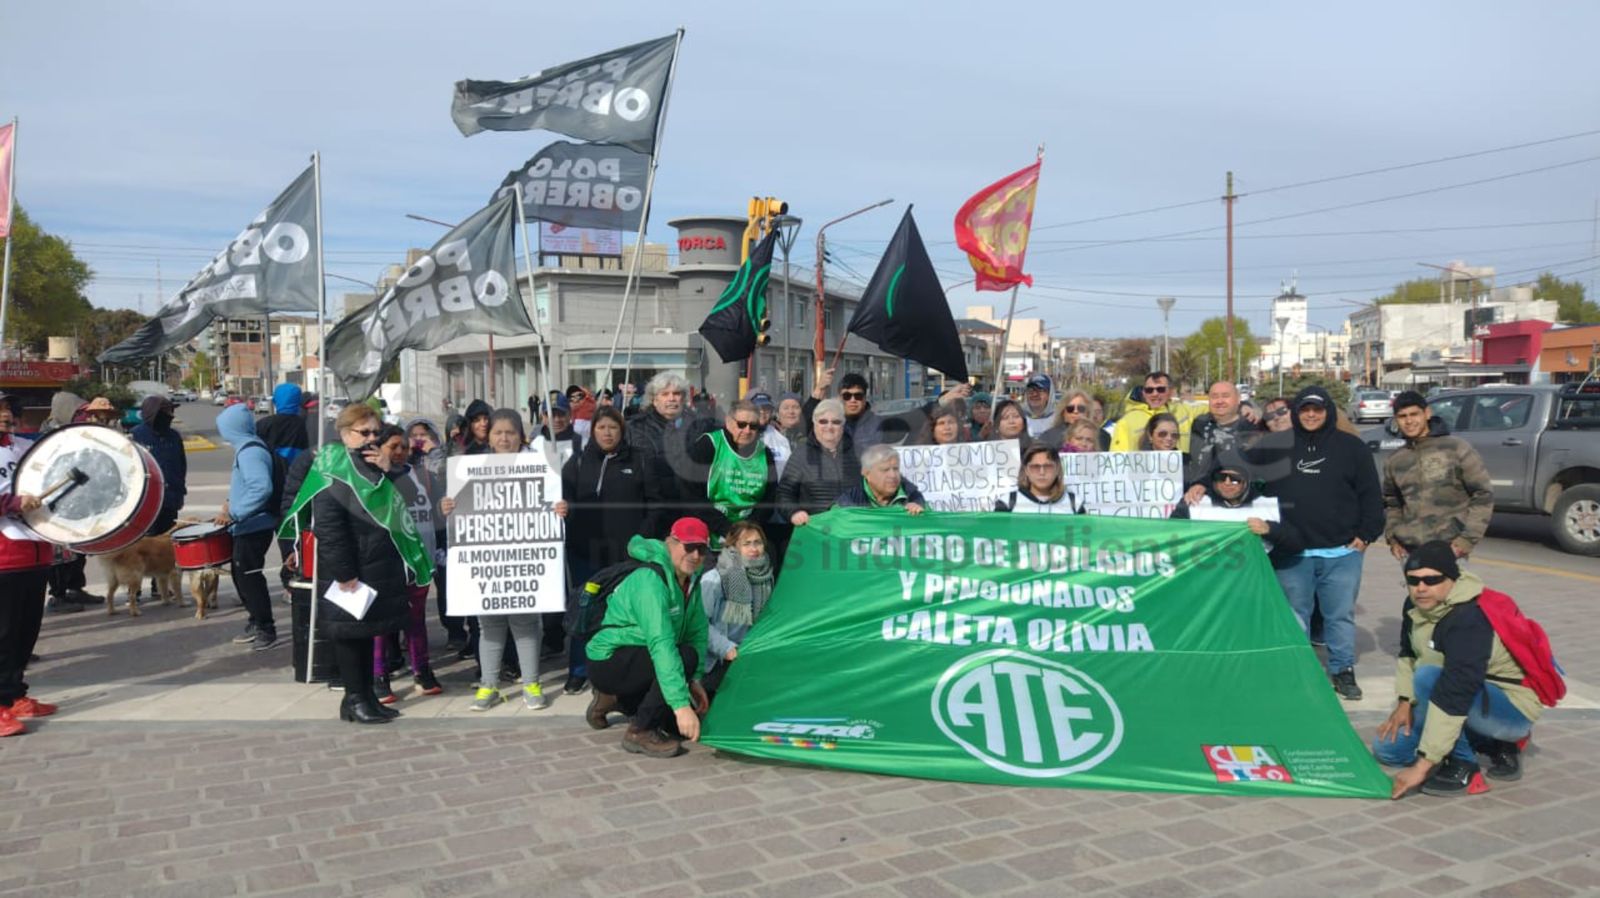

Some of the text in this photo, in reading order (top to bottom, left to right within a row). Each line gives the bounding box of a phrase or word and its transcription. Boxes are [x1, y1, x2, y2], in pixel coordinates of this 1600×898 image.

[899, 442, 1009, 469] ODOS SOMOS
[1094, 451, 1180, 476] PAPARULO
[467, 464, 548, 477] MILEI ES HAMBRE
[473, 480, 543, 511] BASTA DE
[1131, 478, 1176, 503] VETO
[455, 504, 562, 544] PERSECUCIÓN
[458, 547, 557, 564] AL MOVIMIENTO
[973, 536, 1011, 569] DE
[1018, 540, 1176, 579] JUBILADOS
[471, 563, 546, 581] PIQUETERO
[478, 580, 539, 595] Y AL POLO
[899, 570, 918, 601] Y
[482, 595, 536, 611] OBRERO
[881, 609, 1155, 654] CALETA OLIVIA
[947, 662, 1094, 763] ATE
